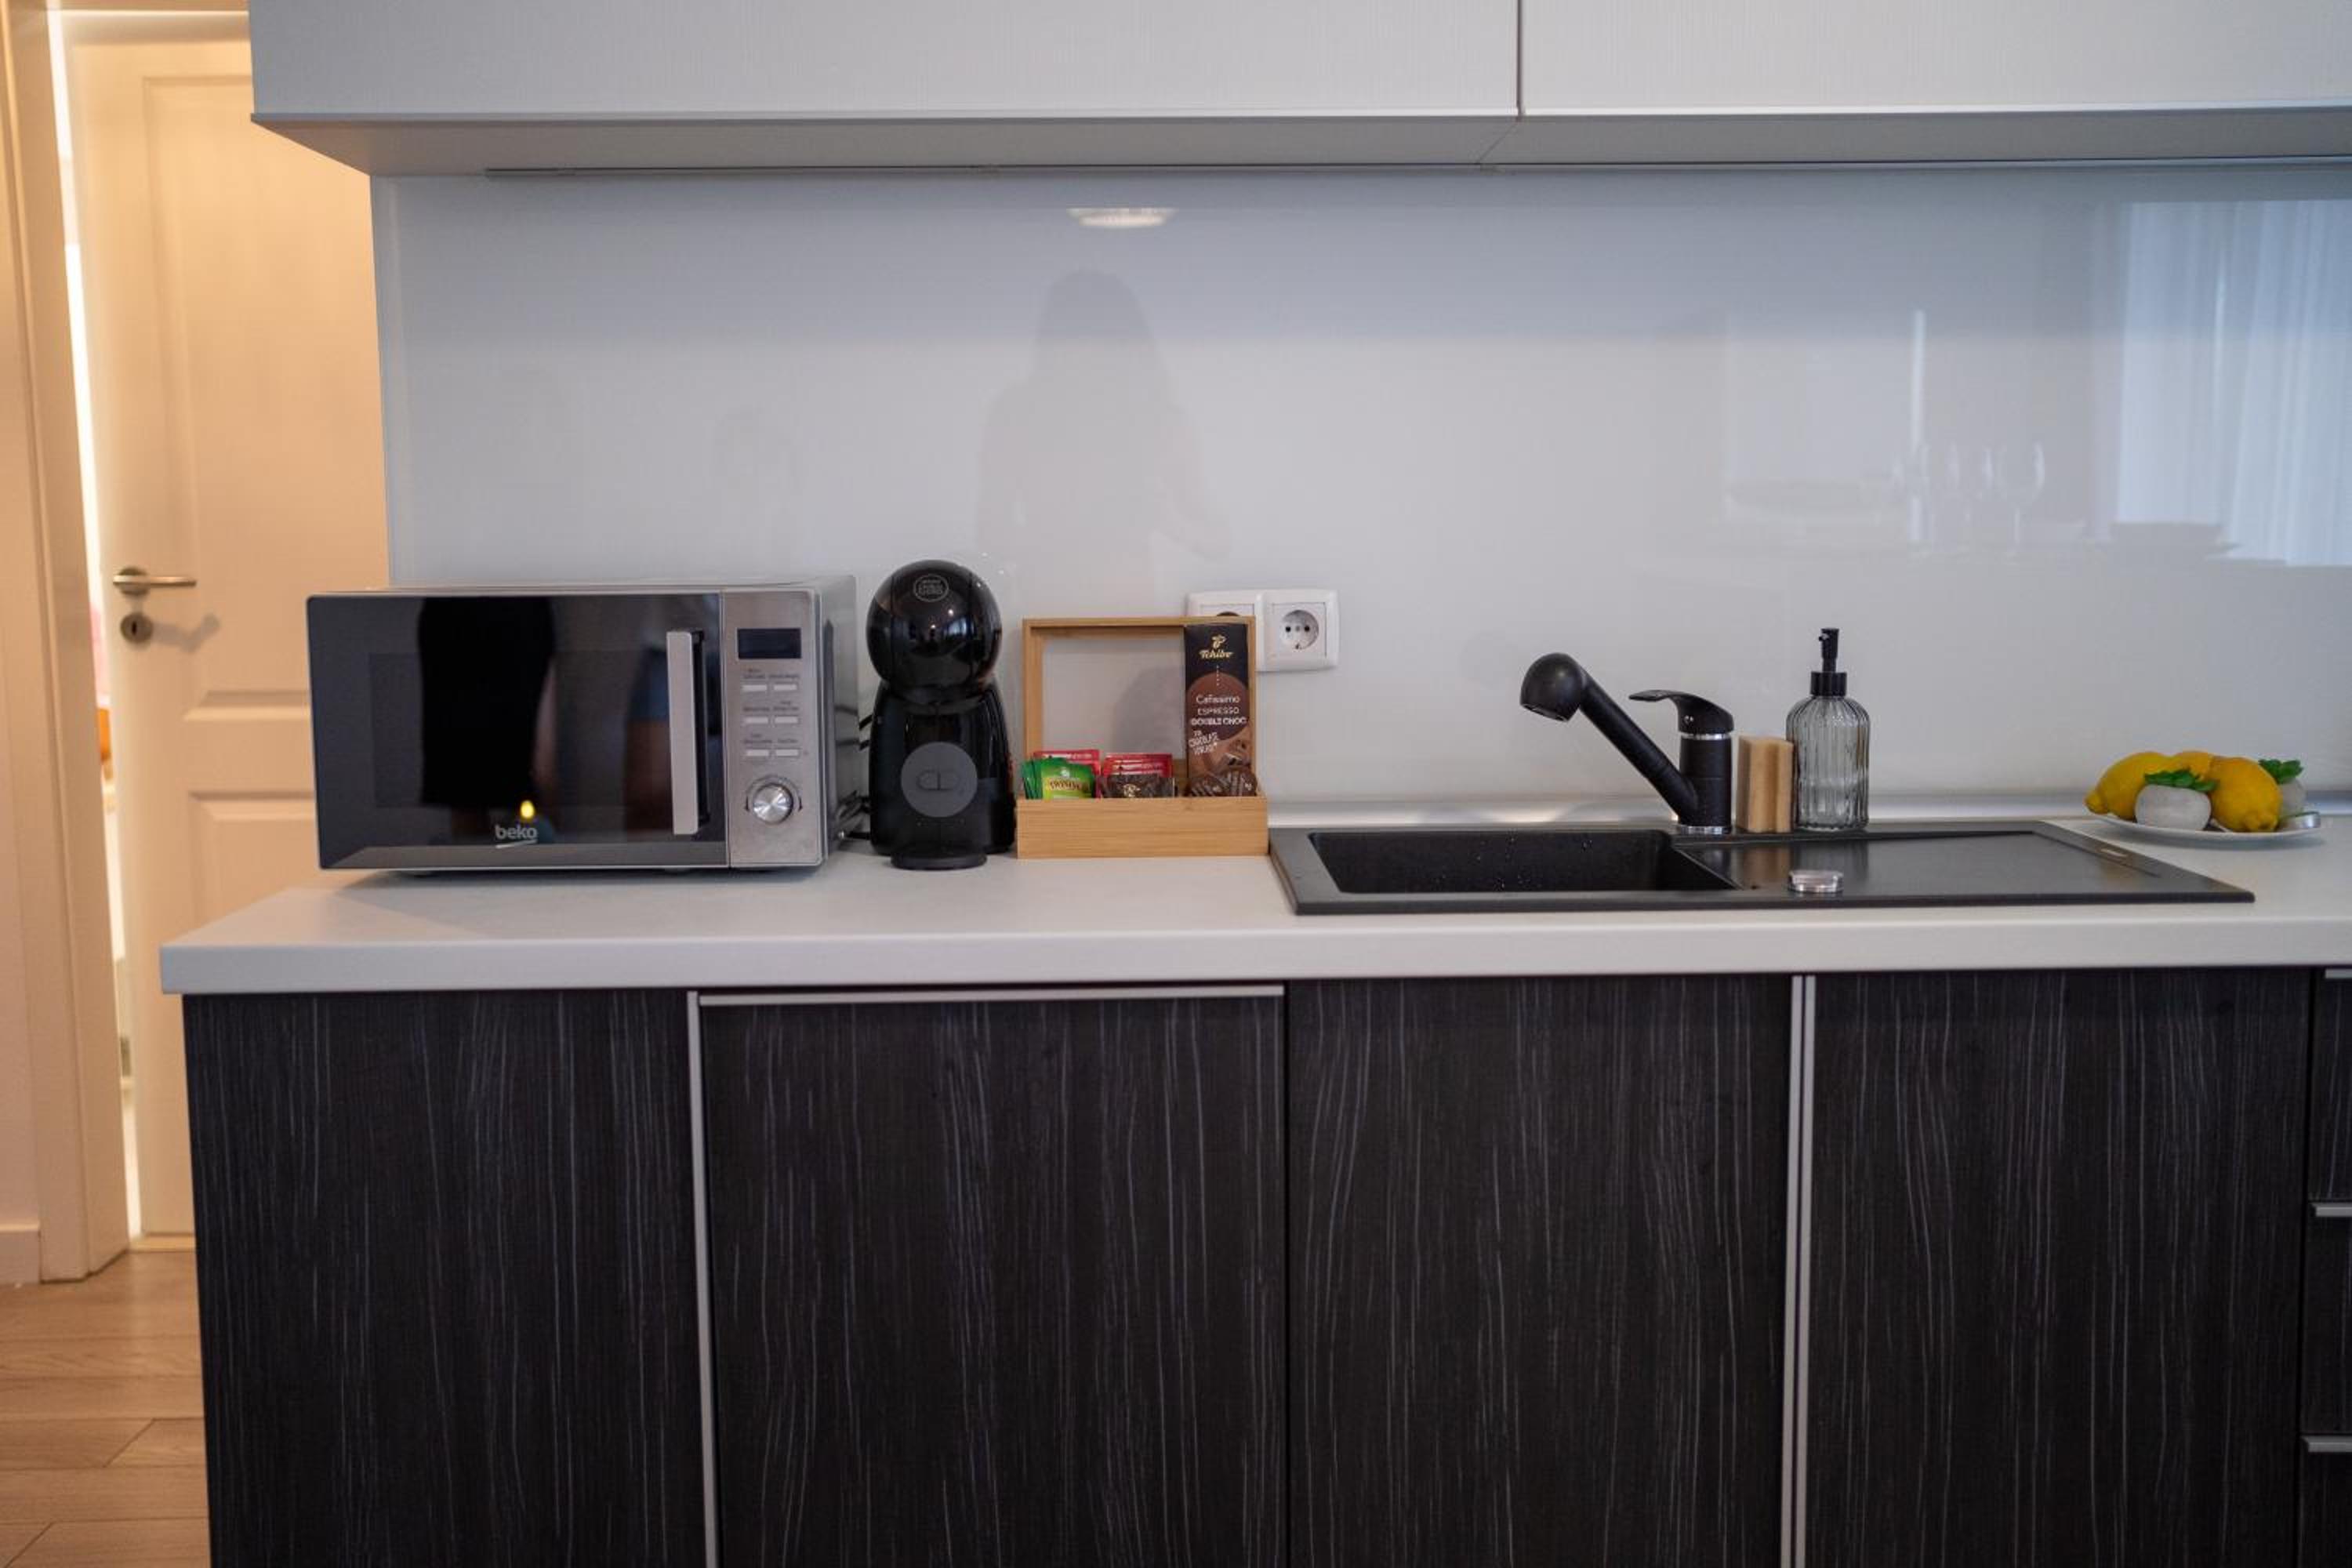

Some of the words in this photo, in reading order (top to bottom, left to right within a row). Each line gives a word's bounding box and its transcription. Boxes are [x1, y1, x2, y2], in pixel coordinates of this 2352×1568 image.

[1200, 649, 1233, 659] Tchibo
[1223, 716, 1247, 725] CHOC
[495, 824, 537, 840] beko
